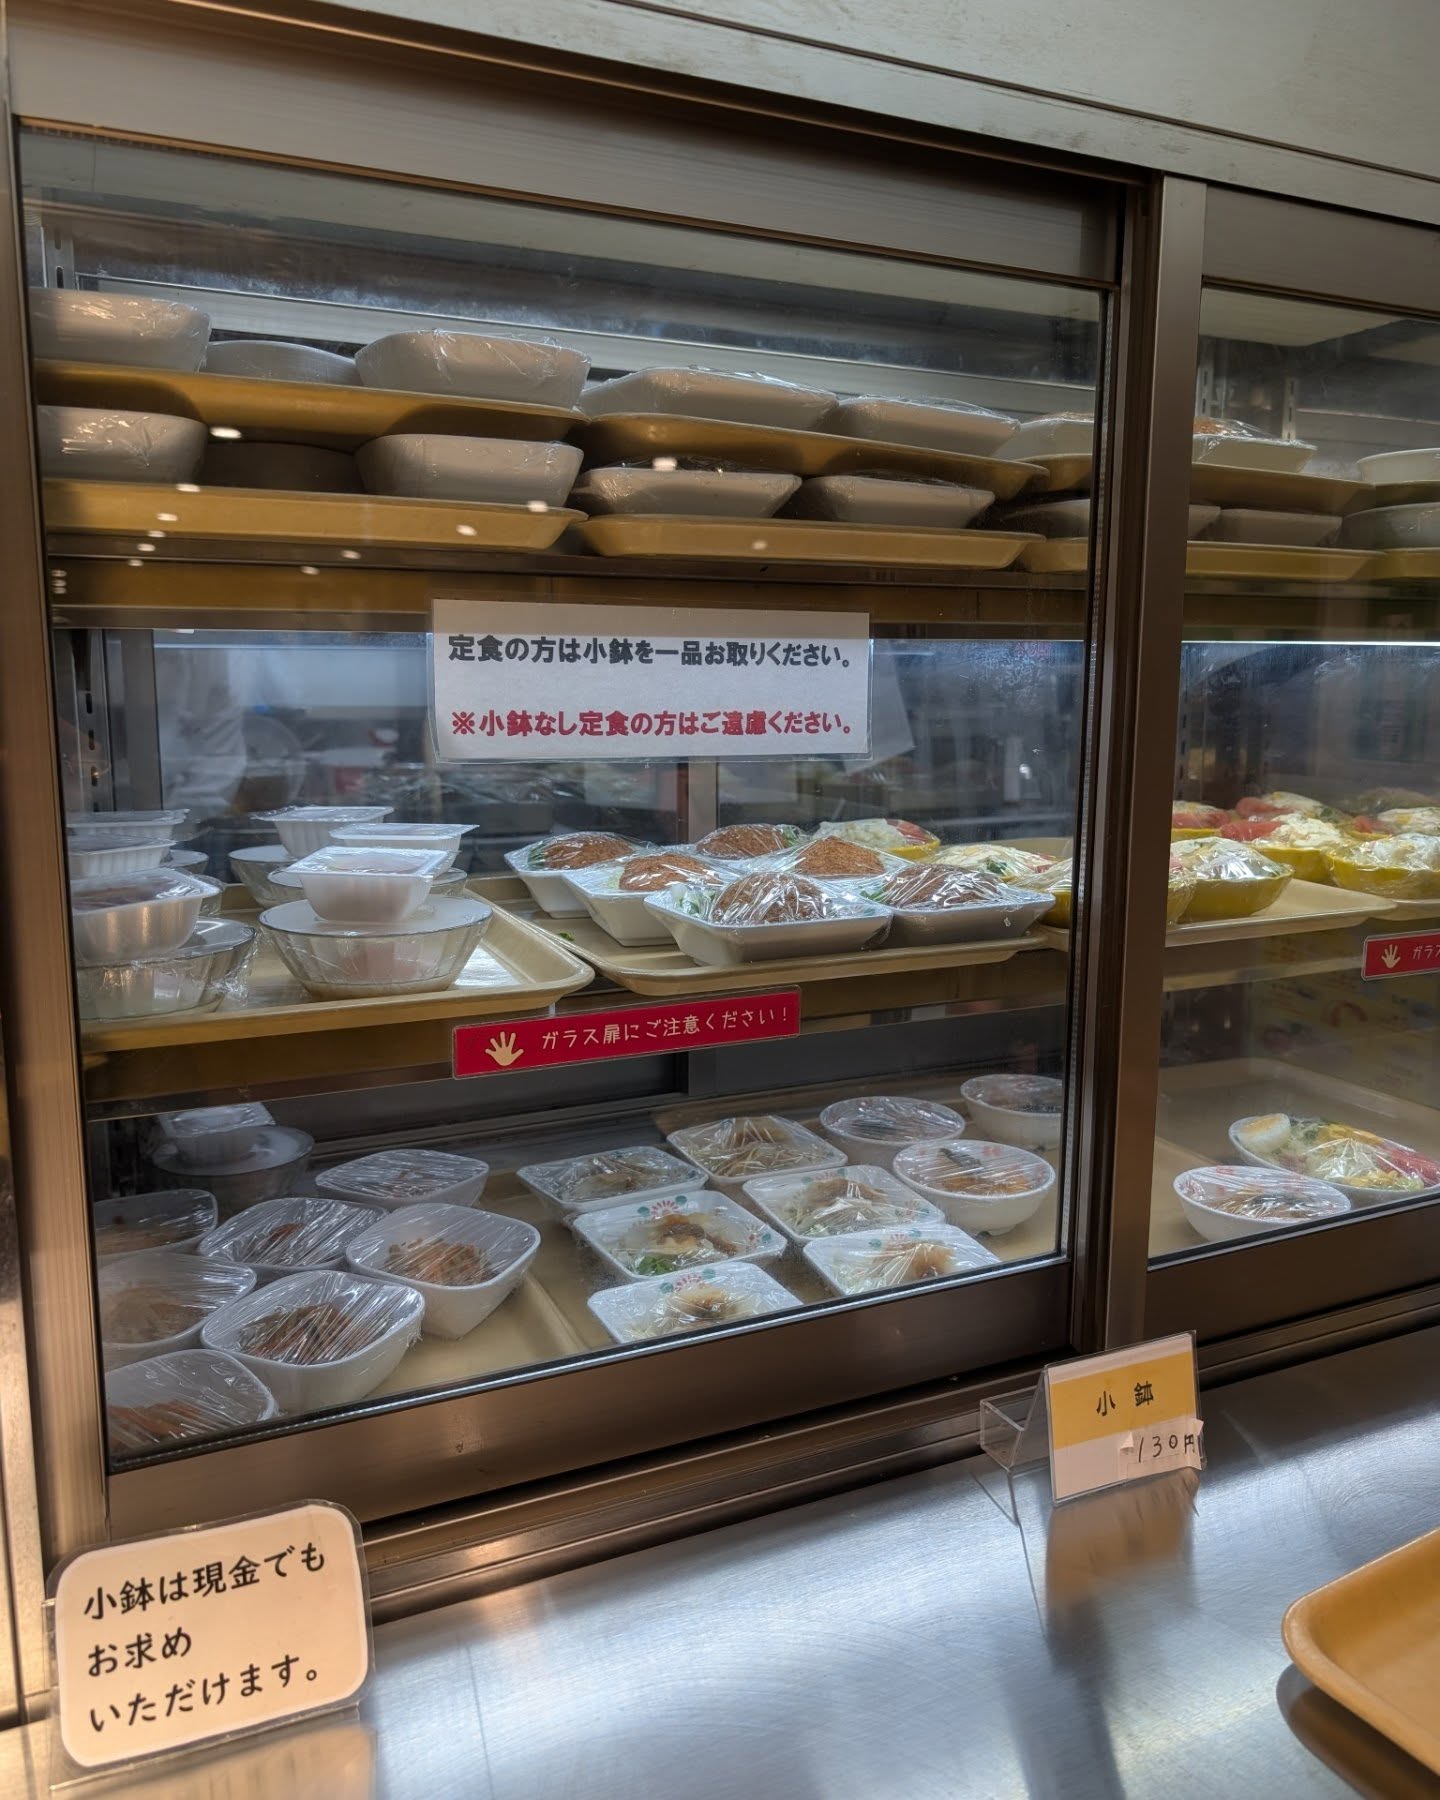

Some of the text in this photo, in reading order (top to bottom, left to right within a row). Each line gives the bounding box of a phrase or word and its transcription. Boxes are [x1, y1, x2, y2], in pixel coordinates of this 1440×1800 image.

[448, 634, 851, 668] 定食の方は小鉢を一品お取りください。
[451, 709, 852, 737] ※小鉢なし定食の方はご遠慮ください。
[84, 1542, 326, 1620] 小鉢は現金でも
[88, 1626, 192, 1677] お求め
[90, 1654, 318, 1732] いただけます。
